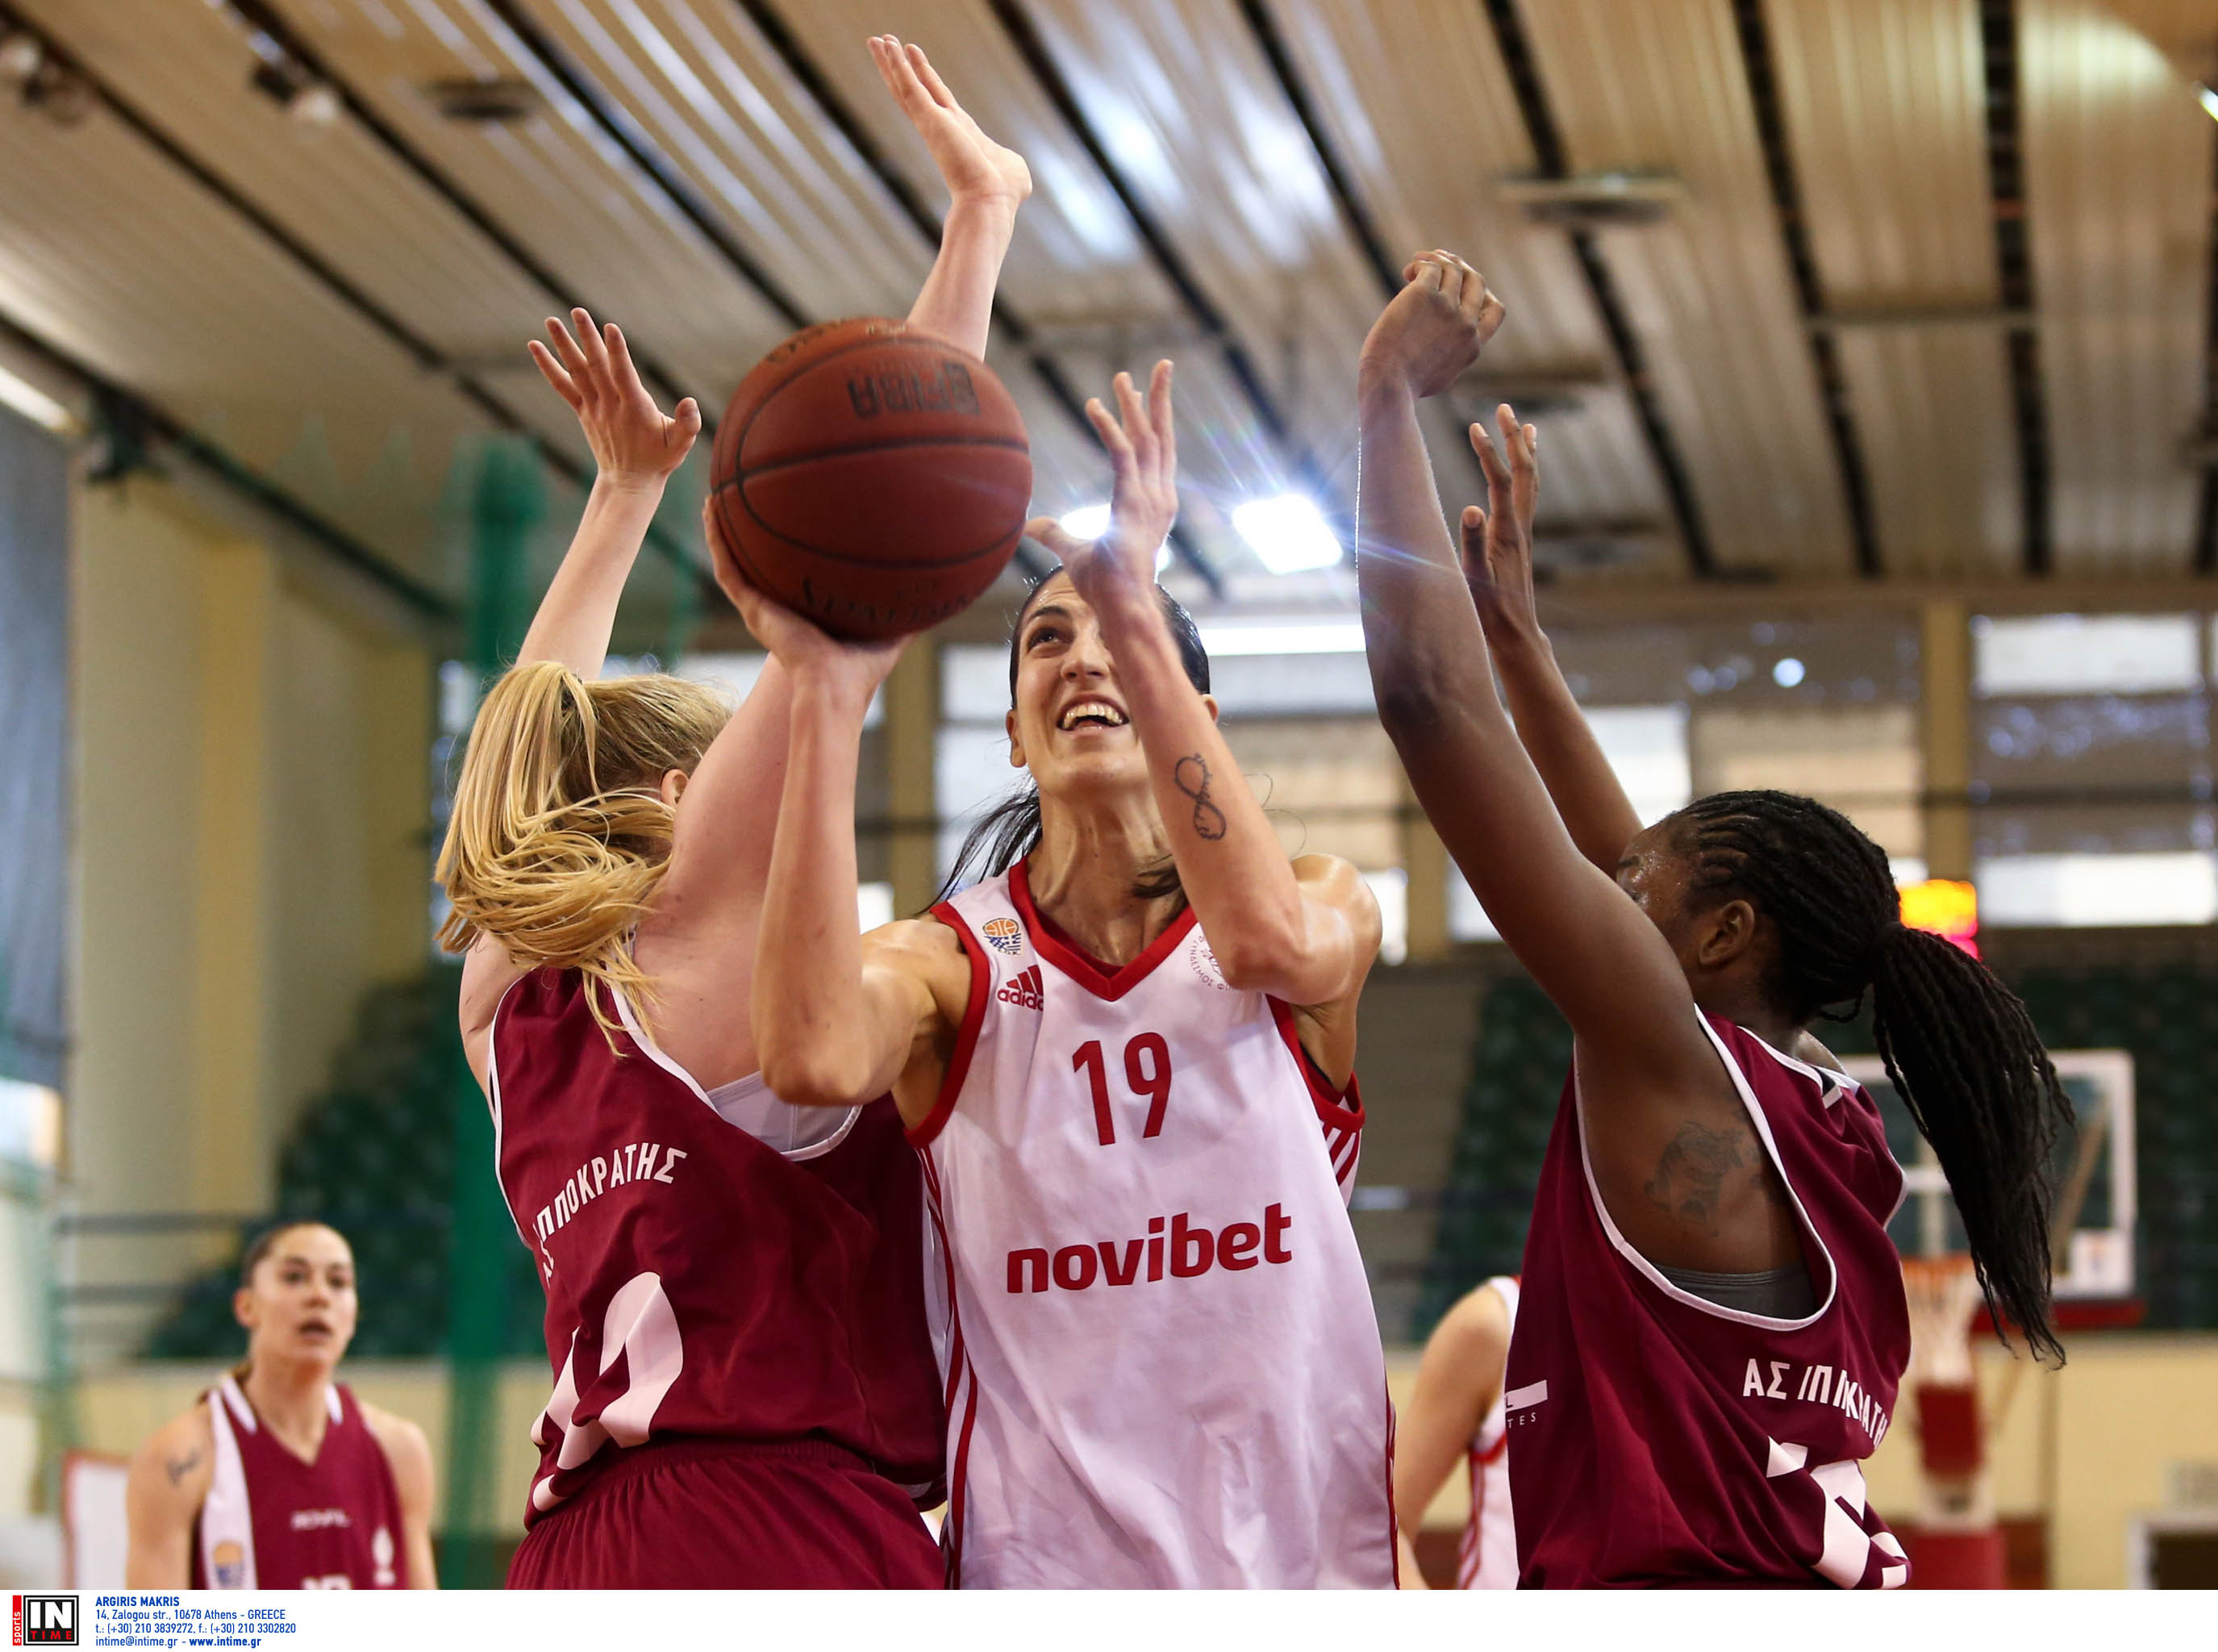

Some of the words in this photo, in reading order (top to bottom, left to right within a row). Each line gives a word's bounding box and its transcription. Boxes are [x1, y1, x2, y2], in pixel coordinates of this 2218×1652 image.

[1073, 1032, 1171, 1145] 19
[1007, 1202, 1292, 1294] novibet
[1742, 1358, 1791, 1401] ΑΣ
